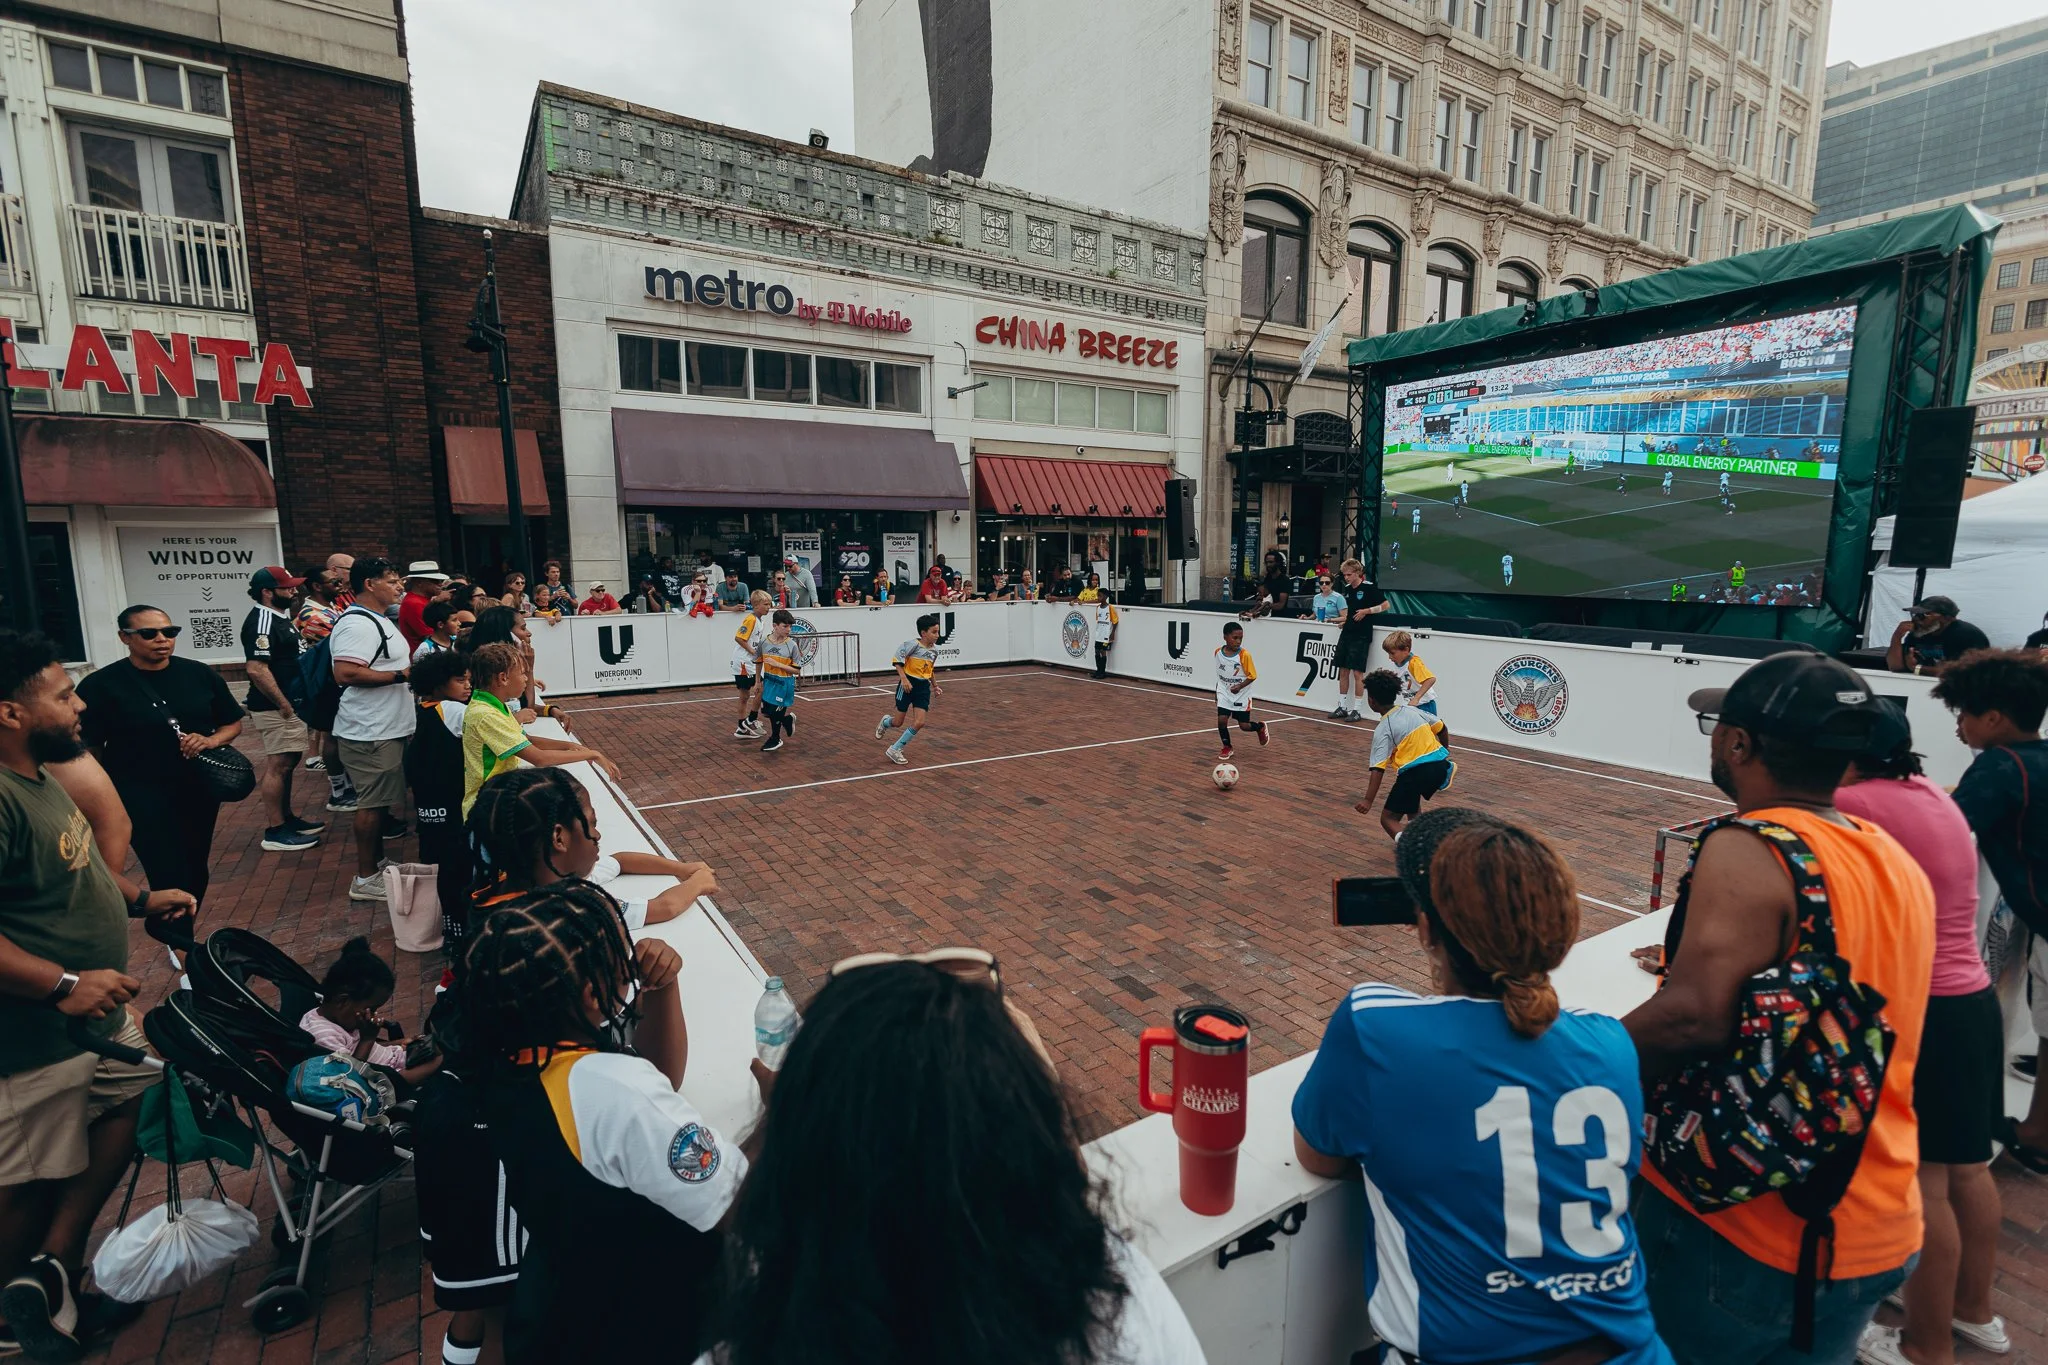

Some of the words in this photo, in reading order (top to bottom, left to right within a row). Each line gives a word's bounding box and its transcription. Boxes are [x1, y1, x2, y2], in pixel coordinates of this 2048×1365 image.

[644, 266, 794, 316] metro
[797, 297, 823, 326] by
[847, 303, 912, 335] Mobile
[975, 315, 1067, 354] CHINA
[1078, 328, 1178, 369] BREEZE
[1752, 354, 1771, 364] LIVE
[1776, 349, 1813, 360] BOSTON
[1780, 353, 1836, 370] BOSTON
[1591, 376, 1606, 386] FIFA
[1606, 375, 1628, 385] WORLD
[1628, 373, 1643, 383] CUP
[1643, 371, 1670, 382] 2026
[1454, 389, 1468, 398] MAR
[1490, 384, 1509, 392] 13:22
[1979, 398, 2048, 418] NDERG
[1427, 444, 1449, 452] aramco
[1474, 445, 1491, 454] GLOBAL
[1491, 446, 1511, 456] ENERGY
[1656, 454, 1692, 469] GLOBAL
[1693, 456, 1737, 472] ENERGY
[1738, 459, 1798, 476] PARTNER
[162, 537, 191, 545] HERE
[209, 537, 237, 545] YOUR
[784, 540, 819, 551] FREE
[148, 550, 253, 566] WINDOW
[841, 551, 870, 567] $20
[158, 573, 172, 581] OF
[176, 572, 250, 581] OPPORTUNITY
[598, 624, 635, 665] U
[1168, 621, 1190, 660] U
[1306, 641, 1338, 658] POINTS
[1163, 663, 1193, 674] UNDERGROUND
[1296, 632, 1323, 697] 5
[1320, 658, 1341, 681] CU
[1502, 660, 1559, 683] RESURGENS
[595, 668, 642, 679] UNDERGROUND
[1496, 689, 1506, 709] 1847
[1551, 696, 1563, 717] 1865
[1183, 1086, 1240, 1103] EXCELLENCE
[1190, 1084, 1229, 1096] SALES
[1182, 1094, 1240, 1113] CHAMPS
[1475, 1085, 1631, 1258] 13
